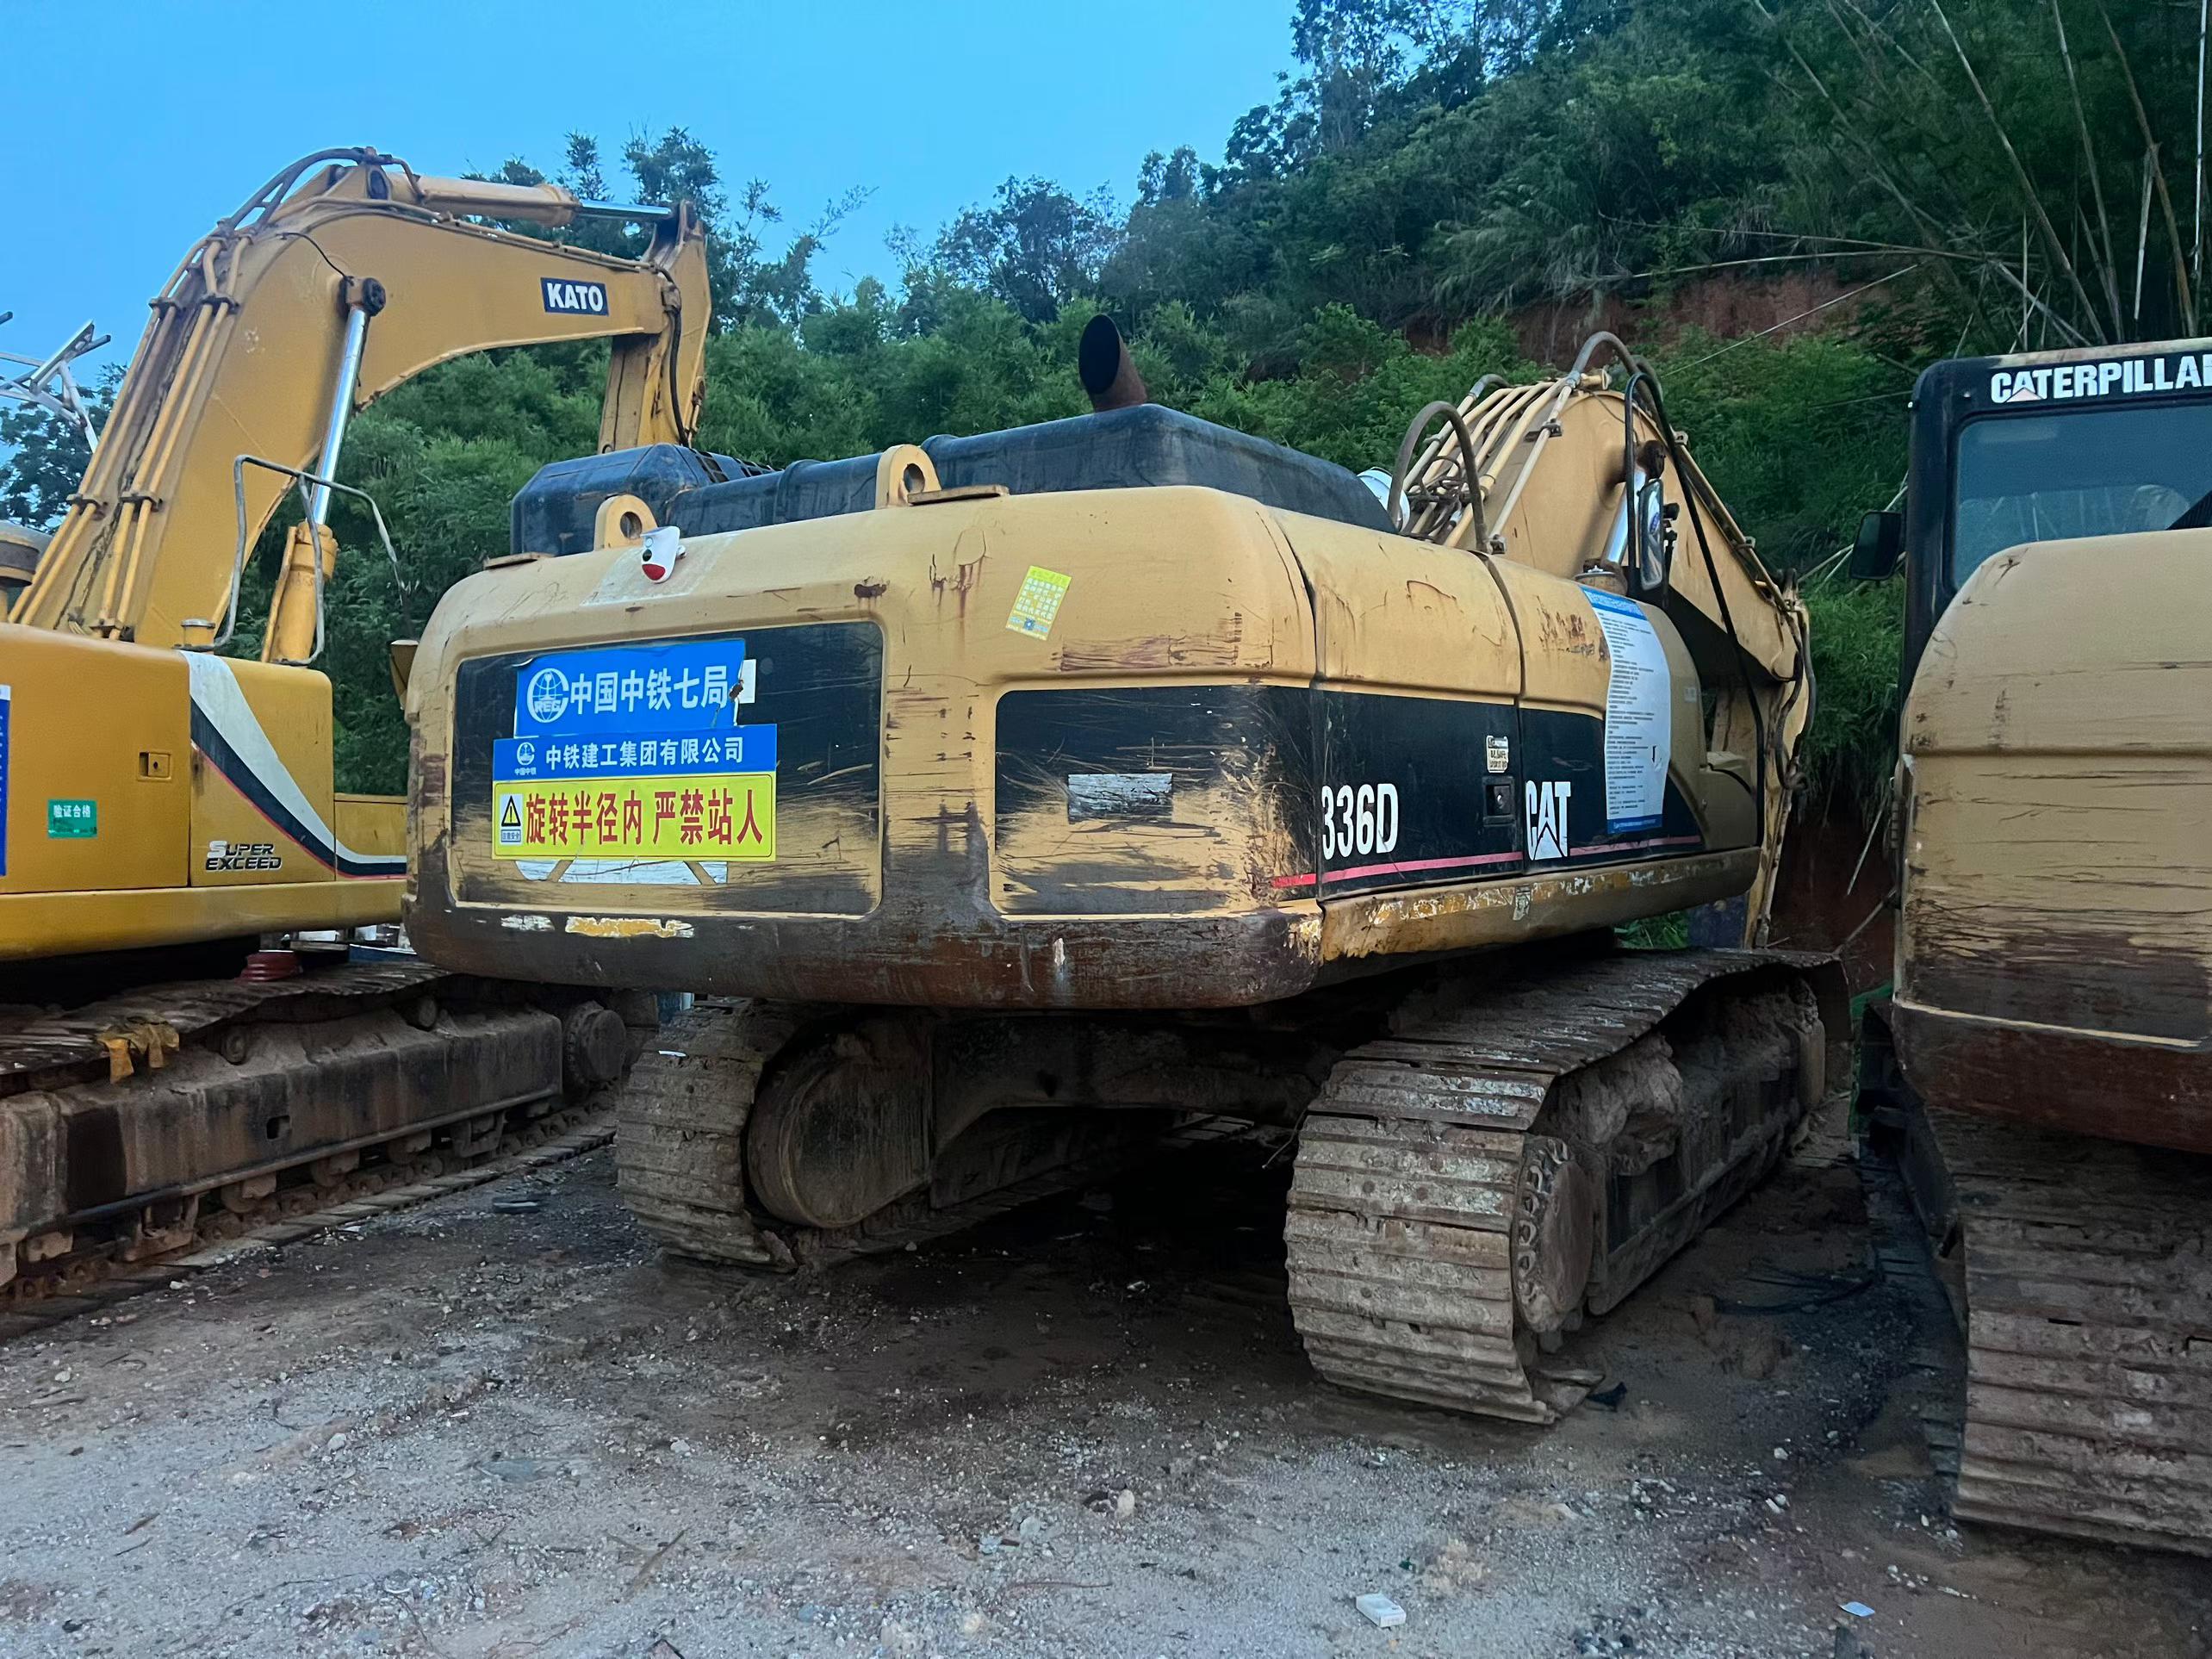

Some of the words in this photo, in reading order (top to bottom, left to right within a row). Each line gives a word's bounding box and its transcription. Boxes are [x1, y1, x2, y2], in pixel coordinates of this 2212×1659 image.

[547, 283, 603, 312] KATO
[570, 665, 728, 715] 中国中铁七局
[545, 736, 743, 771] 中铁建工集团有限公司
[525, 789, 643, 846] 旋转半径内
[653, 787, 763, 846] 严禁站人
[1321, 783, 1399, 861] 336D
[1525, 780, 1571, 861] CAT
[205, 857, 283, 871] EXCEED
